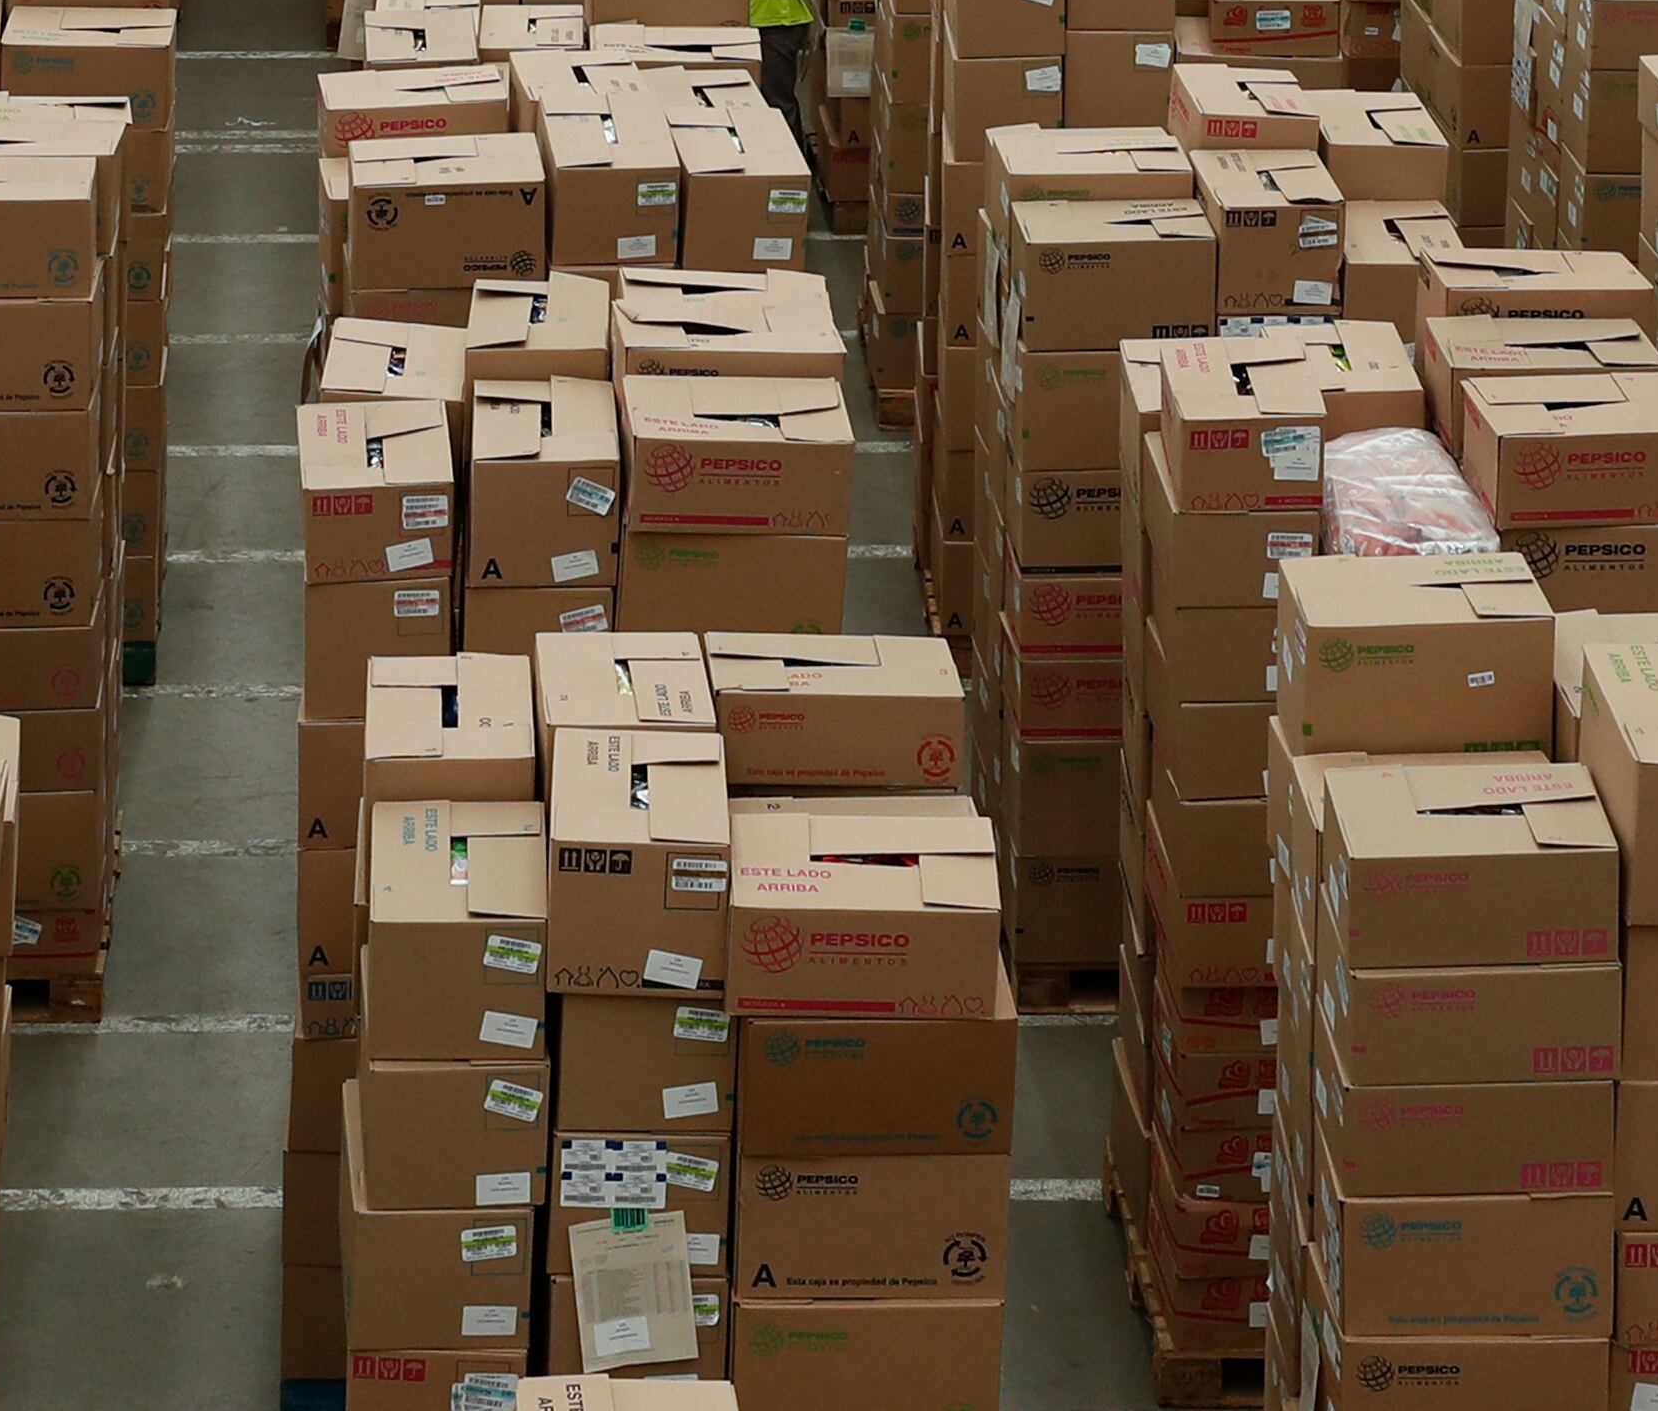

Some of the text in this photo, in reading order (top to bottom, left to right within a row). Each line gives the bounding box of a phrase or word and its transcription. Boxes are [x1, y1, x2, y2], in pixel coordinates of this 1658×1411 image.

[380, 118, 447, 132] PEPSICO
[1467, 130, 1479, 143] A
[520, 189, 536, 205] A
[1567, 451, 1646, 464] PEPSICO
[701, 459, 783, 471] PEPSICO
[1567, 470, 1644, 479] ALIMENTOS
[1076, 488, 1121, 498] PEPSI
[950, 519, 964, 535] A
[1565, 545, 1645, 556] PEPSICO
[481, 558, 501, 580] A
[1564, 562, 1644, 570] ALIMENTOS
[1077, 596, 1121, 605] PEPSI
[747, 768, 763, 776] Esta
[767, 769, 783, 777] caja
[799, 769, 837, 778] propiedad
[853, 770, 885, 778] Pepsico
[308, 818, 327, 837] A
[403, 817, 415, 845] ARRIBA
[425, 809, 438, 851] ESTE LADO
[740, 868, 831, 879] ESTE LADO
[757, 883, 819, 892] ARRIBA
[811, 931, 910, 947] PEPSICO
[808, 957, 908, 965] ALIMENTOS
[797, 1174, 859, 1184] PEPSICO
[1623, 1198, 1648, 1221] A
[751, 1265, 776, 1287] A
[787, 1278, 806, 1286] Esta
[809, 1278, 826, 1287] caja
[842, 1278, 886, 1287] propiedad
[889, 1278, 899, 1286] de
[902, 1278, 937, 1287] Pepsico
[1398, 1365, 1460, 1376] PEPSICO
